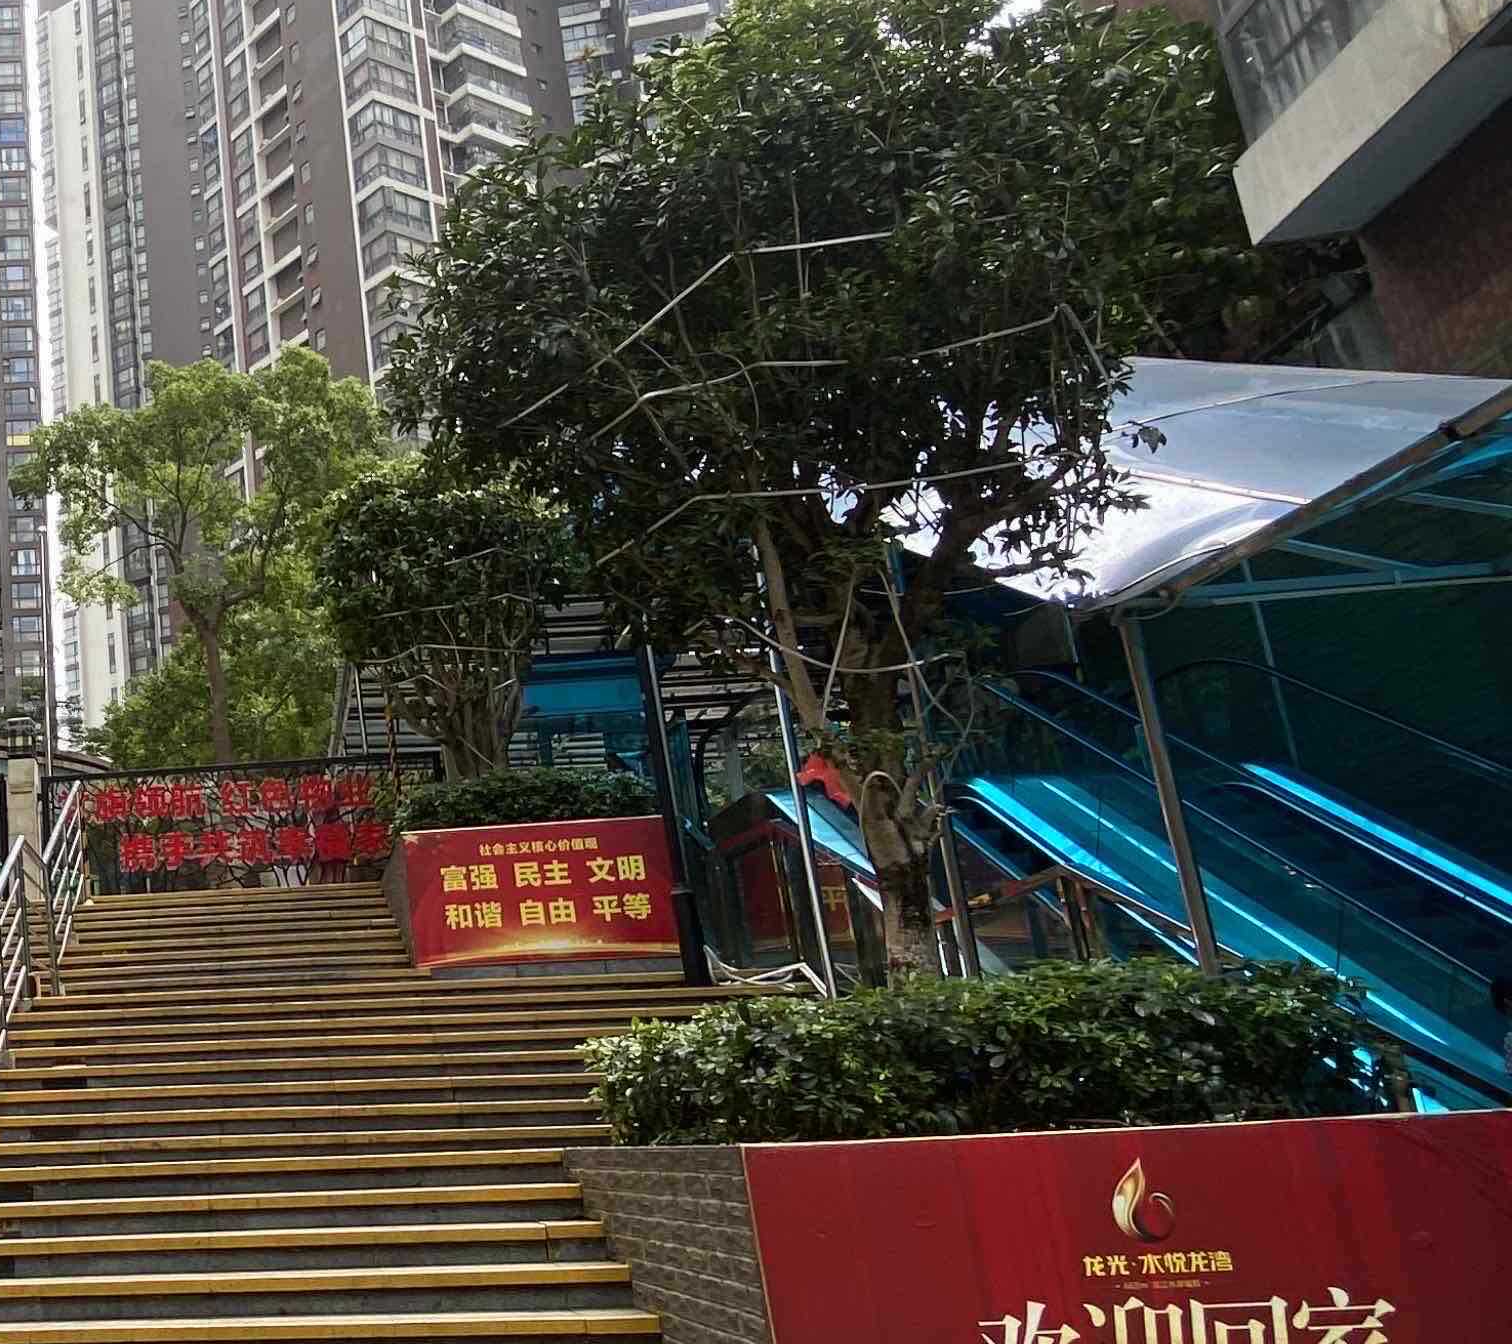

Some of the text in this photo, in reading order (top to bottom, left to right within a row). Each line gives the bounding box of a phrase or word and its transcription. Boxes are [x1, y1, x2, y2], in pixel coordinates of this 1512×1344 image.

[479, 837, 598, 856] 社会主义核心价值观
[440, 855, 646, 892] 富强 民主 文明
[445, 892, 652, 929] 和谐 自由 平等
